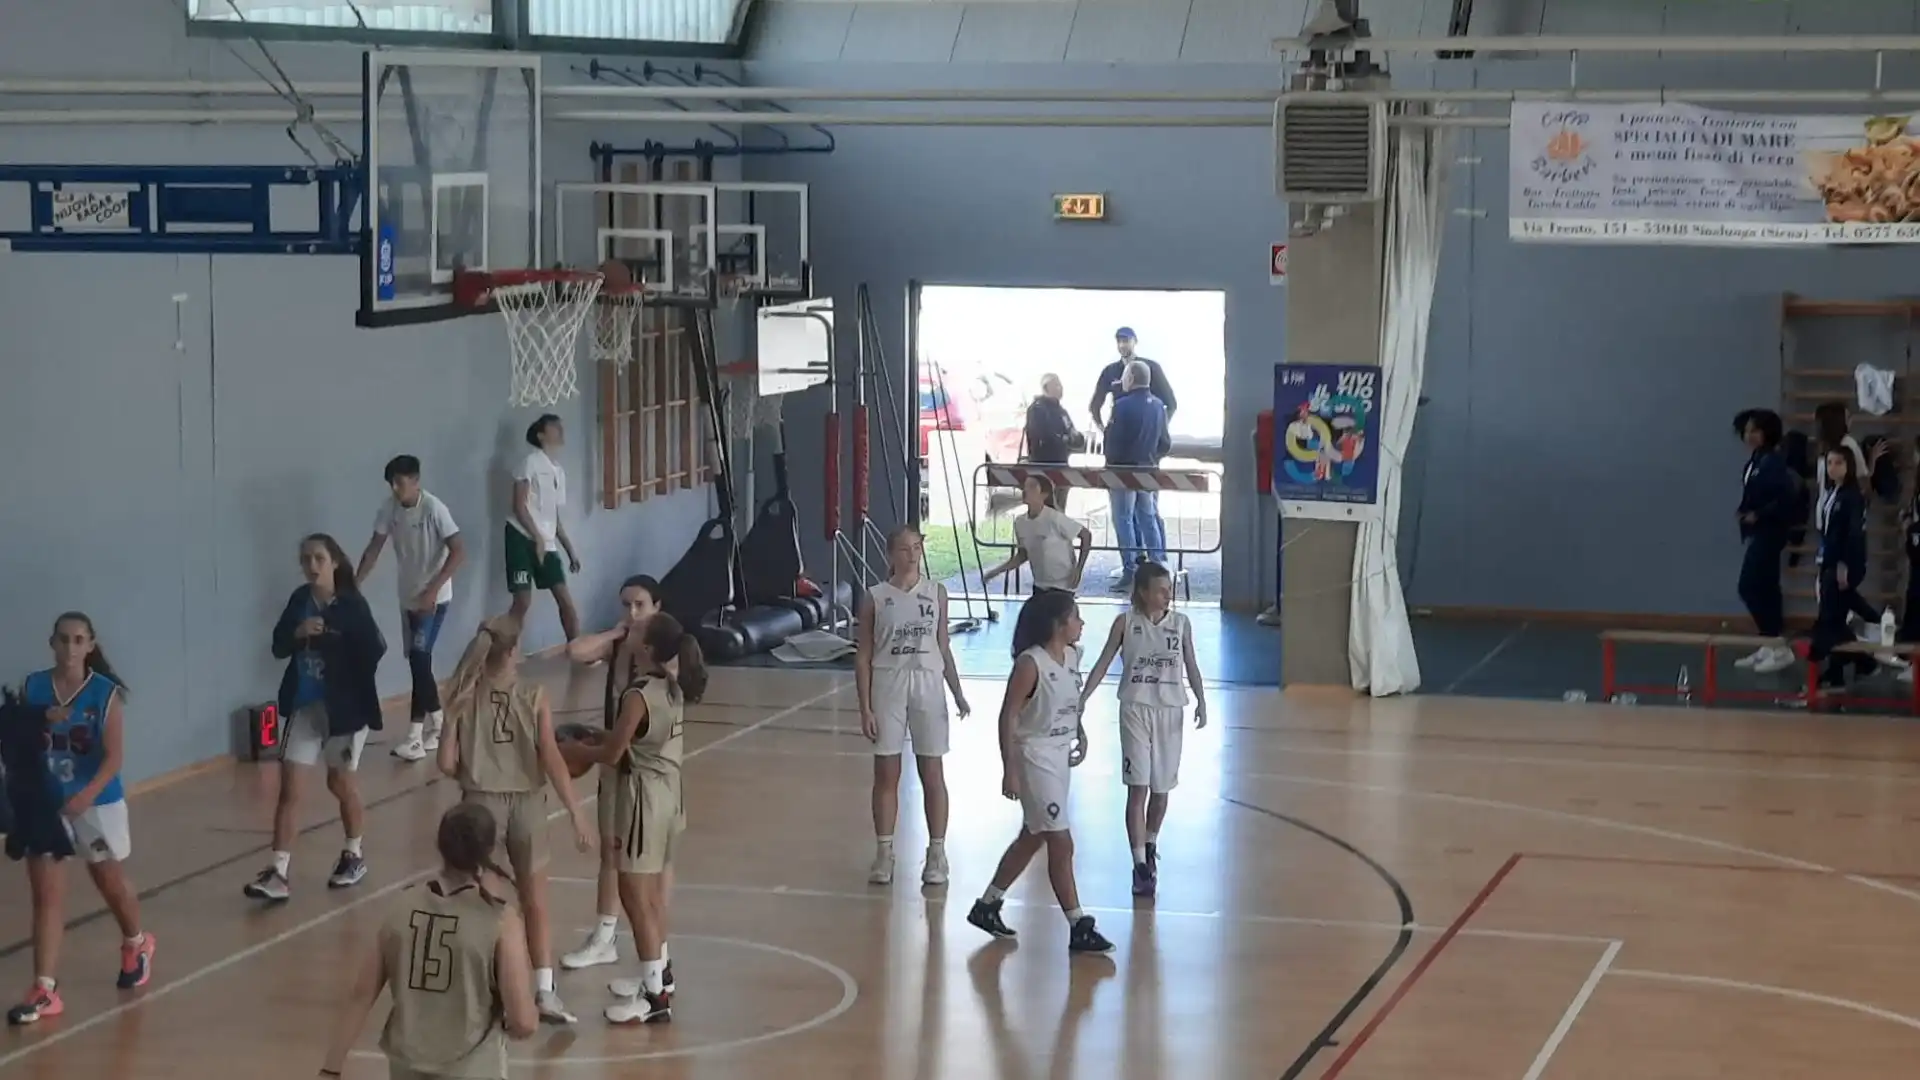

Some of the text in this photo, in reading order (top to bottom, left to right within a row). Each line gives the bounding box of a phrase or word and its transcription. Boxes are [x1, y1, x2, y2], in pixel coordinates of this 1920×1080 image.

[1713, 131, 1733, 147] DI
[1740, 132, 1797, 148] MARE
[1523, 221, 1543, 233] Via
[1338, 371, 1376, 386] VIVI
[918, 604, 934, 618] 14
[1166, 636, 1180, 650] 12
[490, 691, 514, 744] 2
[408, 909, 460, 994] 15
